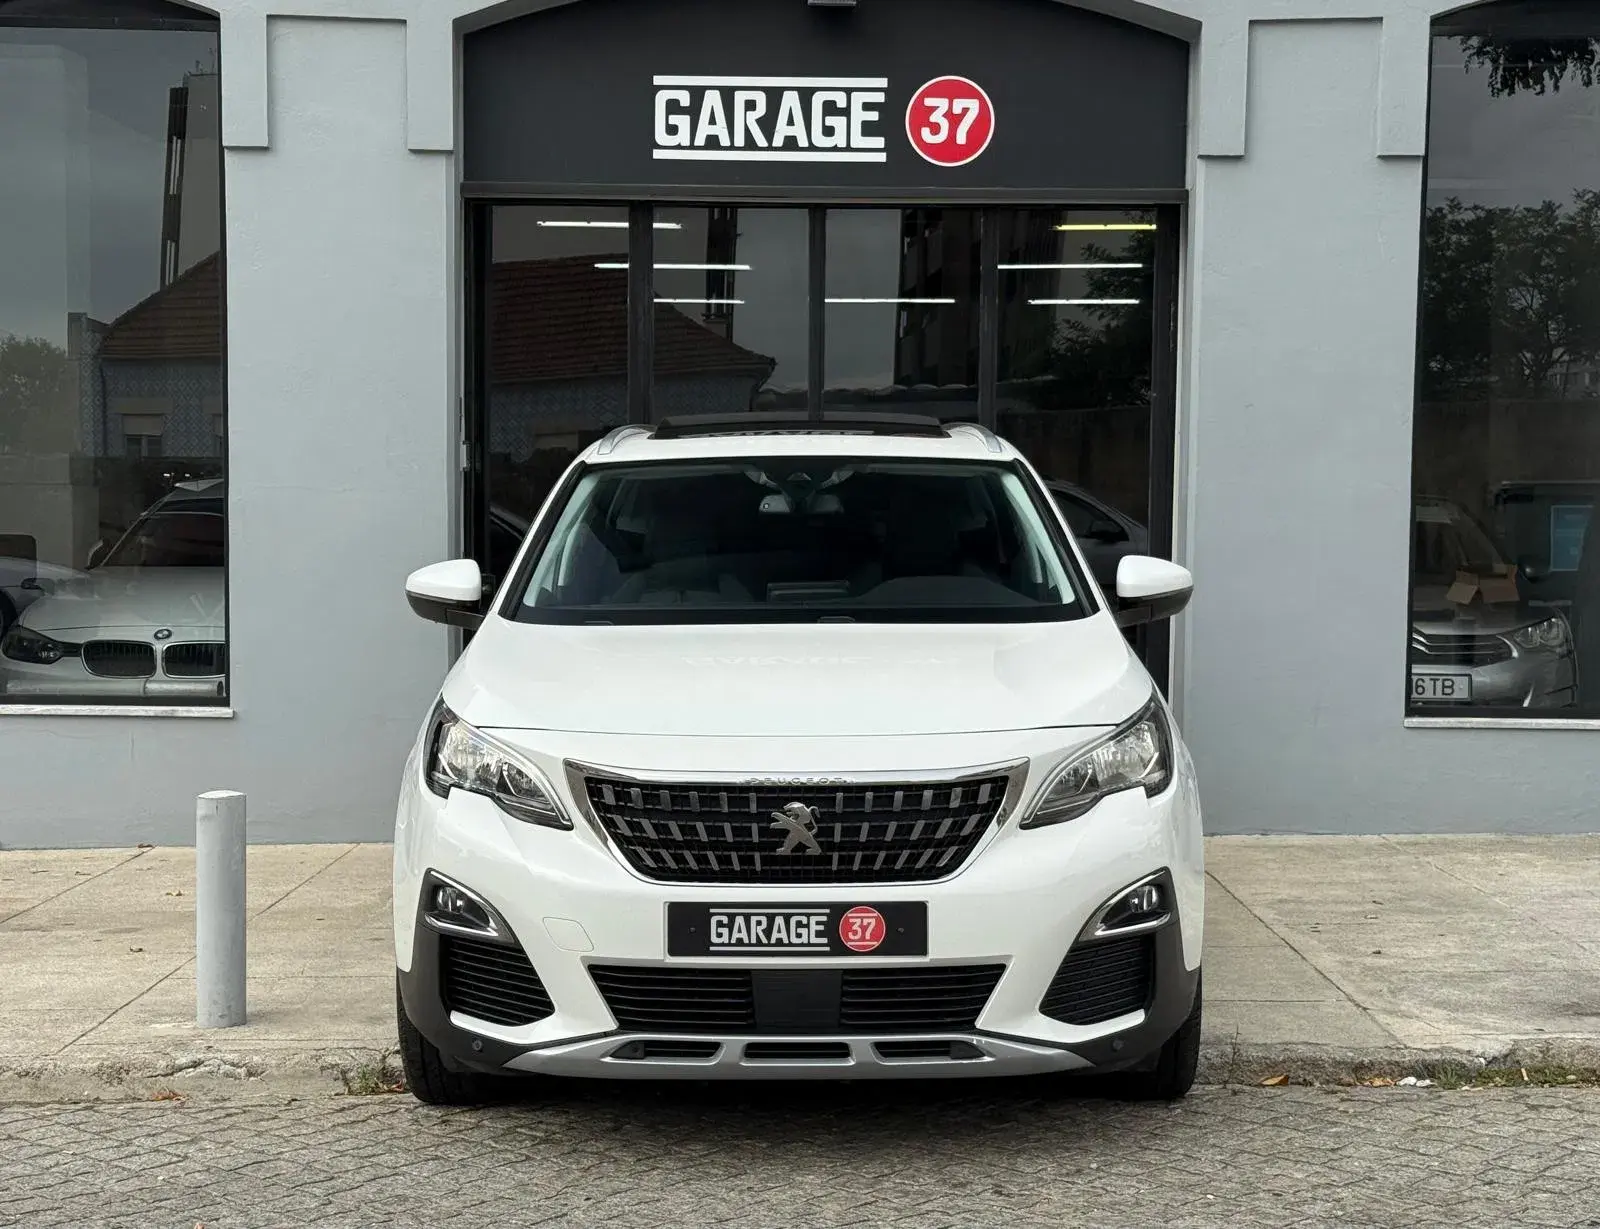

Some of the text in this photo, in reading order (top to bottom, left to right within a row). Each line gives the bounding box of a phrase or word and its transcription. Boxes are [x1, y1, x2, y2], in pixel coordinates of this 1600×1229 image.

[655, 90, 980, 148] GARAGE 37
[1411, 678, 1455, 696] 6TB
[749, 777, 843, 786] PEUGEOT
[710, 915, 876, 944] GARAGE 37
